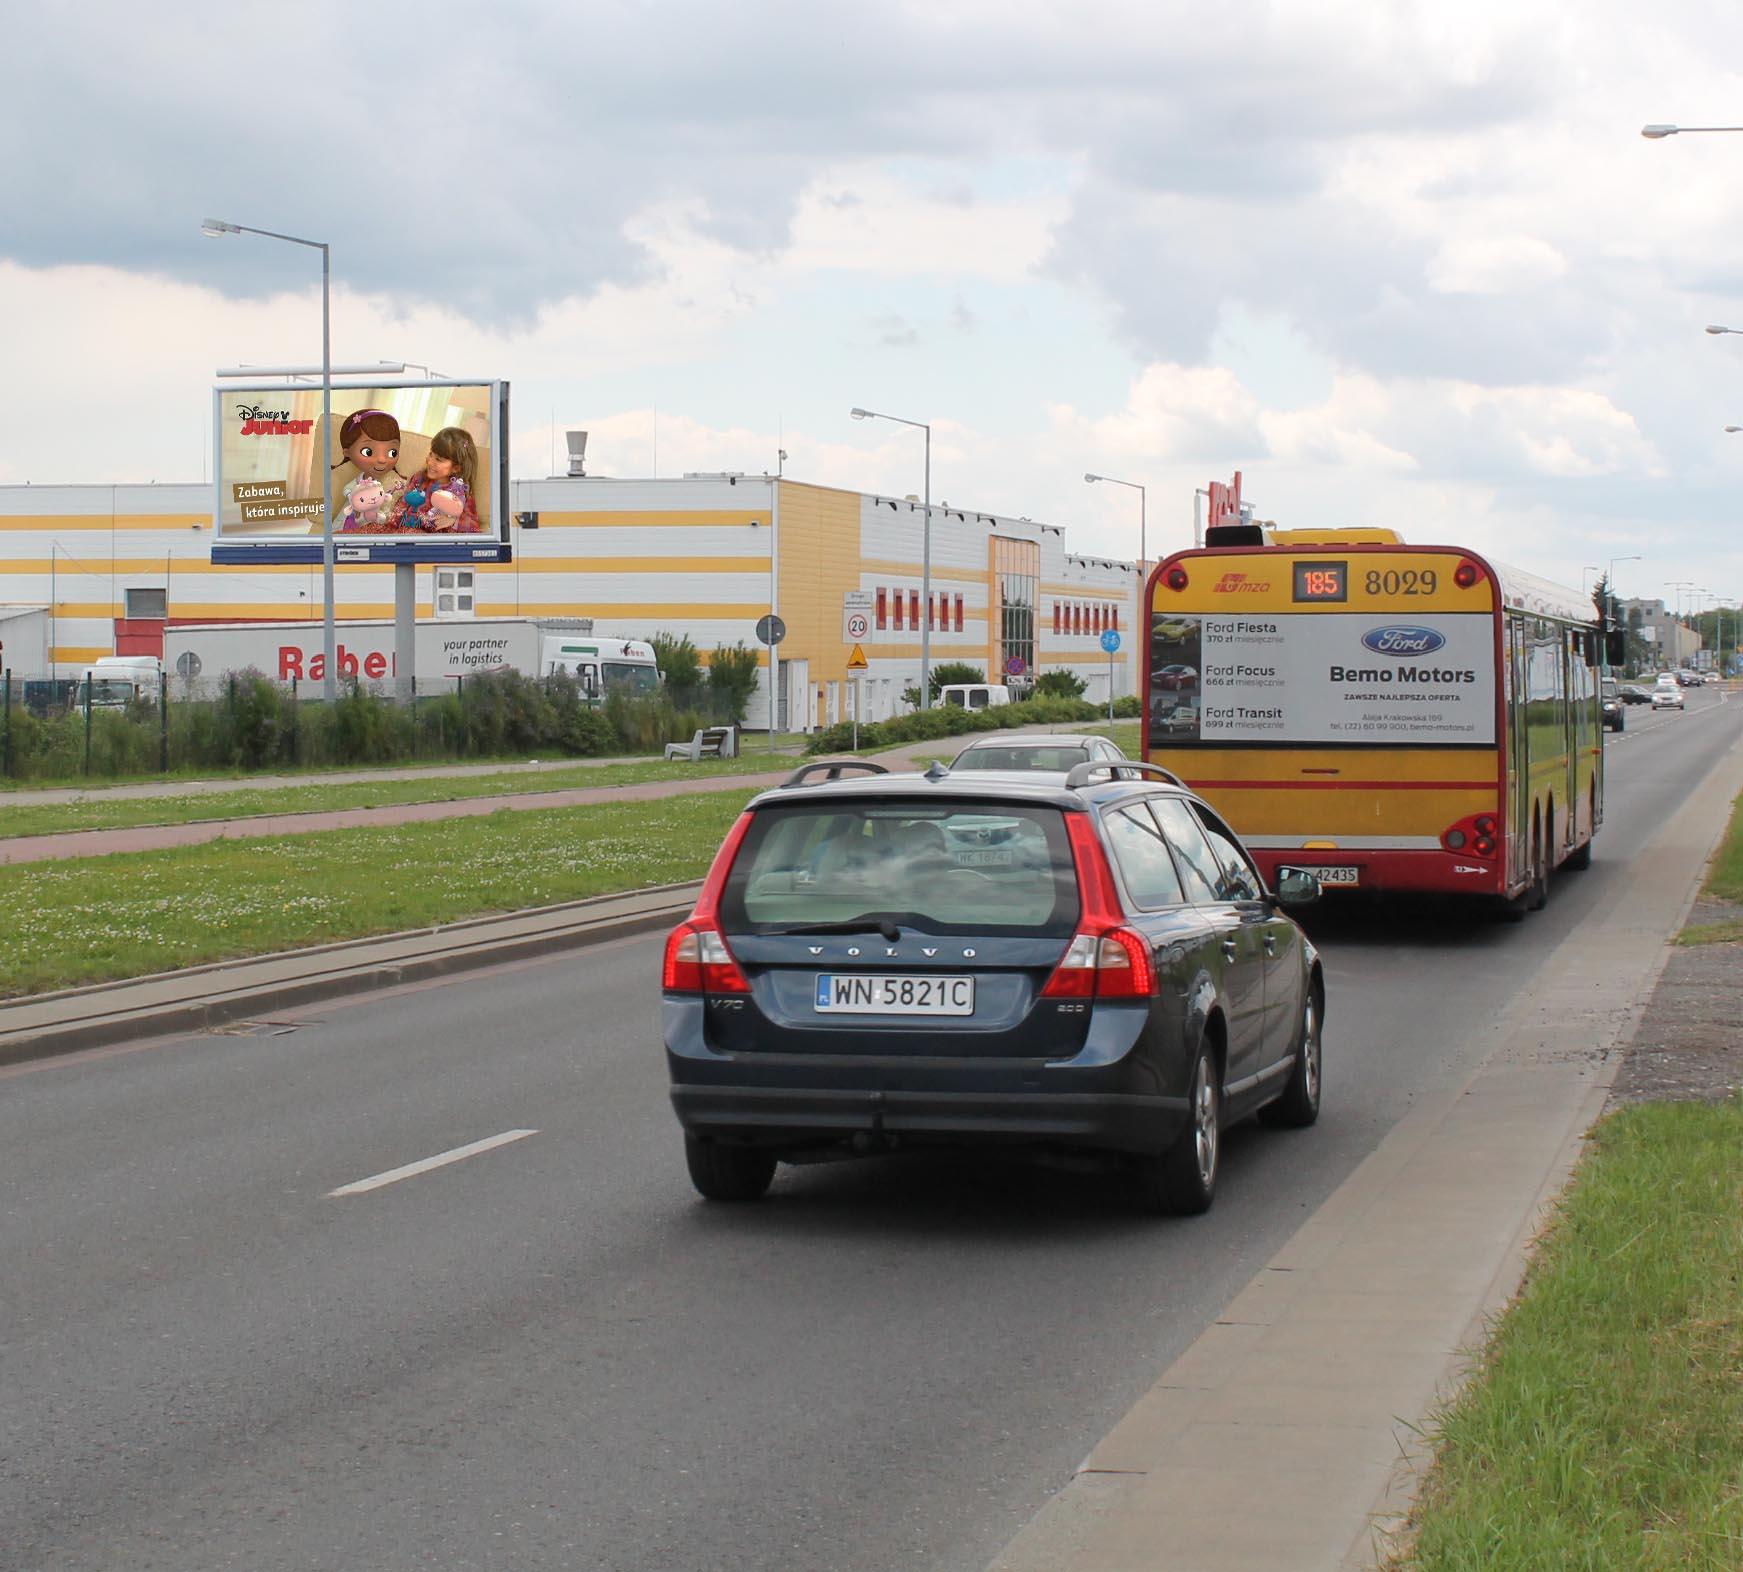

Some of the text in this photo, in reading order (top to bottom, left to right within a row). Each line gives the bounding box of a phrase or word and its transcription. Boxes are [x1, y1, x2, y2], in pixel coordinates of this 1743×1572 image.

[236, 404, 280, 424] Disney
[240, 418, 314, 436] Junior
[238, 485, 284, 498] Zabawa,
[246, 502, 325, 518] która inspiruje
[1304, 570, 1338, 595] 185
[1365, 570, 1437, 595] 8029
[851, 620, 865, 632] 20
[1206, 622, 1277, 633] Ford Fiesta
[444, 638, 508, 652] your partner
[1207, 635, 1224, 643] 370
[1225, 635, 1233, 643] zł
[1377, 628, 1430, 650] Ford
[279, 644, 396, 681] Rabe
[449, 652, 503, 666] in logistics
[1206, 665, 1276, 676] Ford Focus
[1330, 666, 1476, 683] Bemo Motors
[1225, 678, 1234, 686] zł
[1344, 693, 1461, 702] ZAWSZE NAJLEPSZA OFERTA
[1206, 707, 1283, 719] Ford Transit
[1384, 714, 1427, 722] Krakowska
[1225, 720, 1233, 729] zł
[1315, 868, 1356, 882] 42435
[808, 946, 976, 959] VOLVO
[834, 978, 968, 1007] WN 5821C
